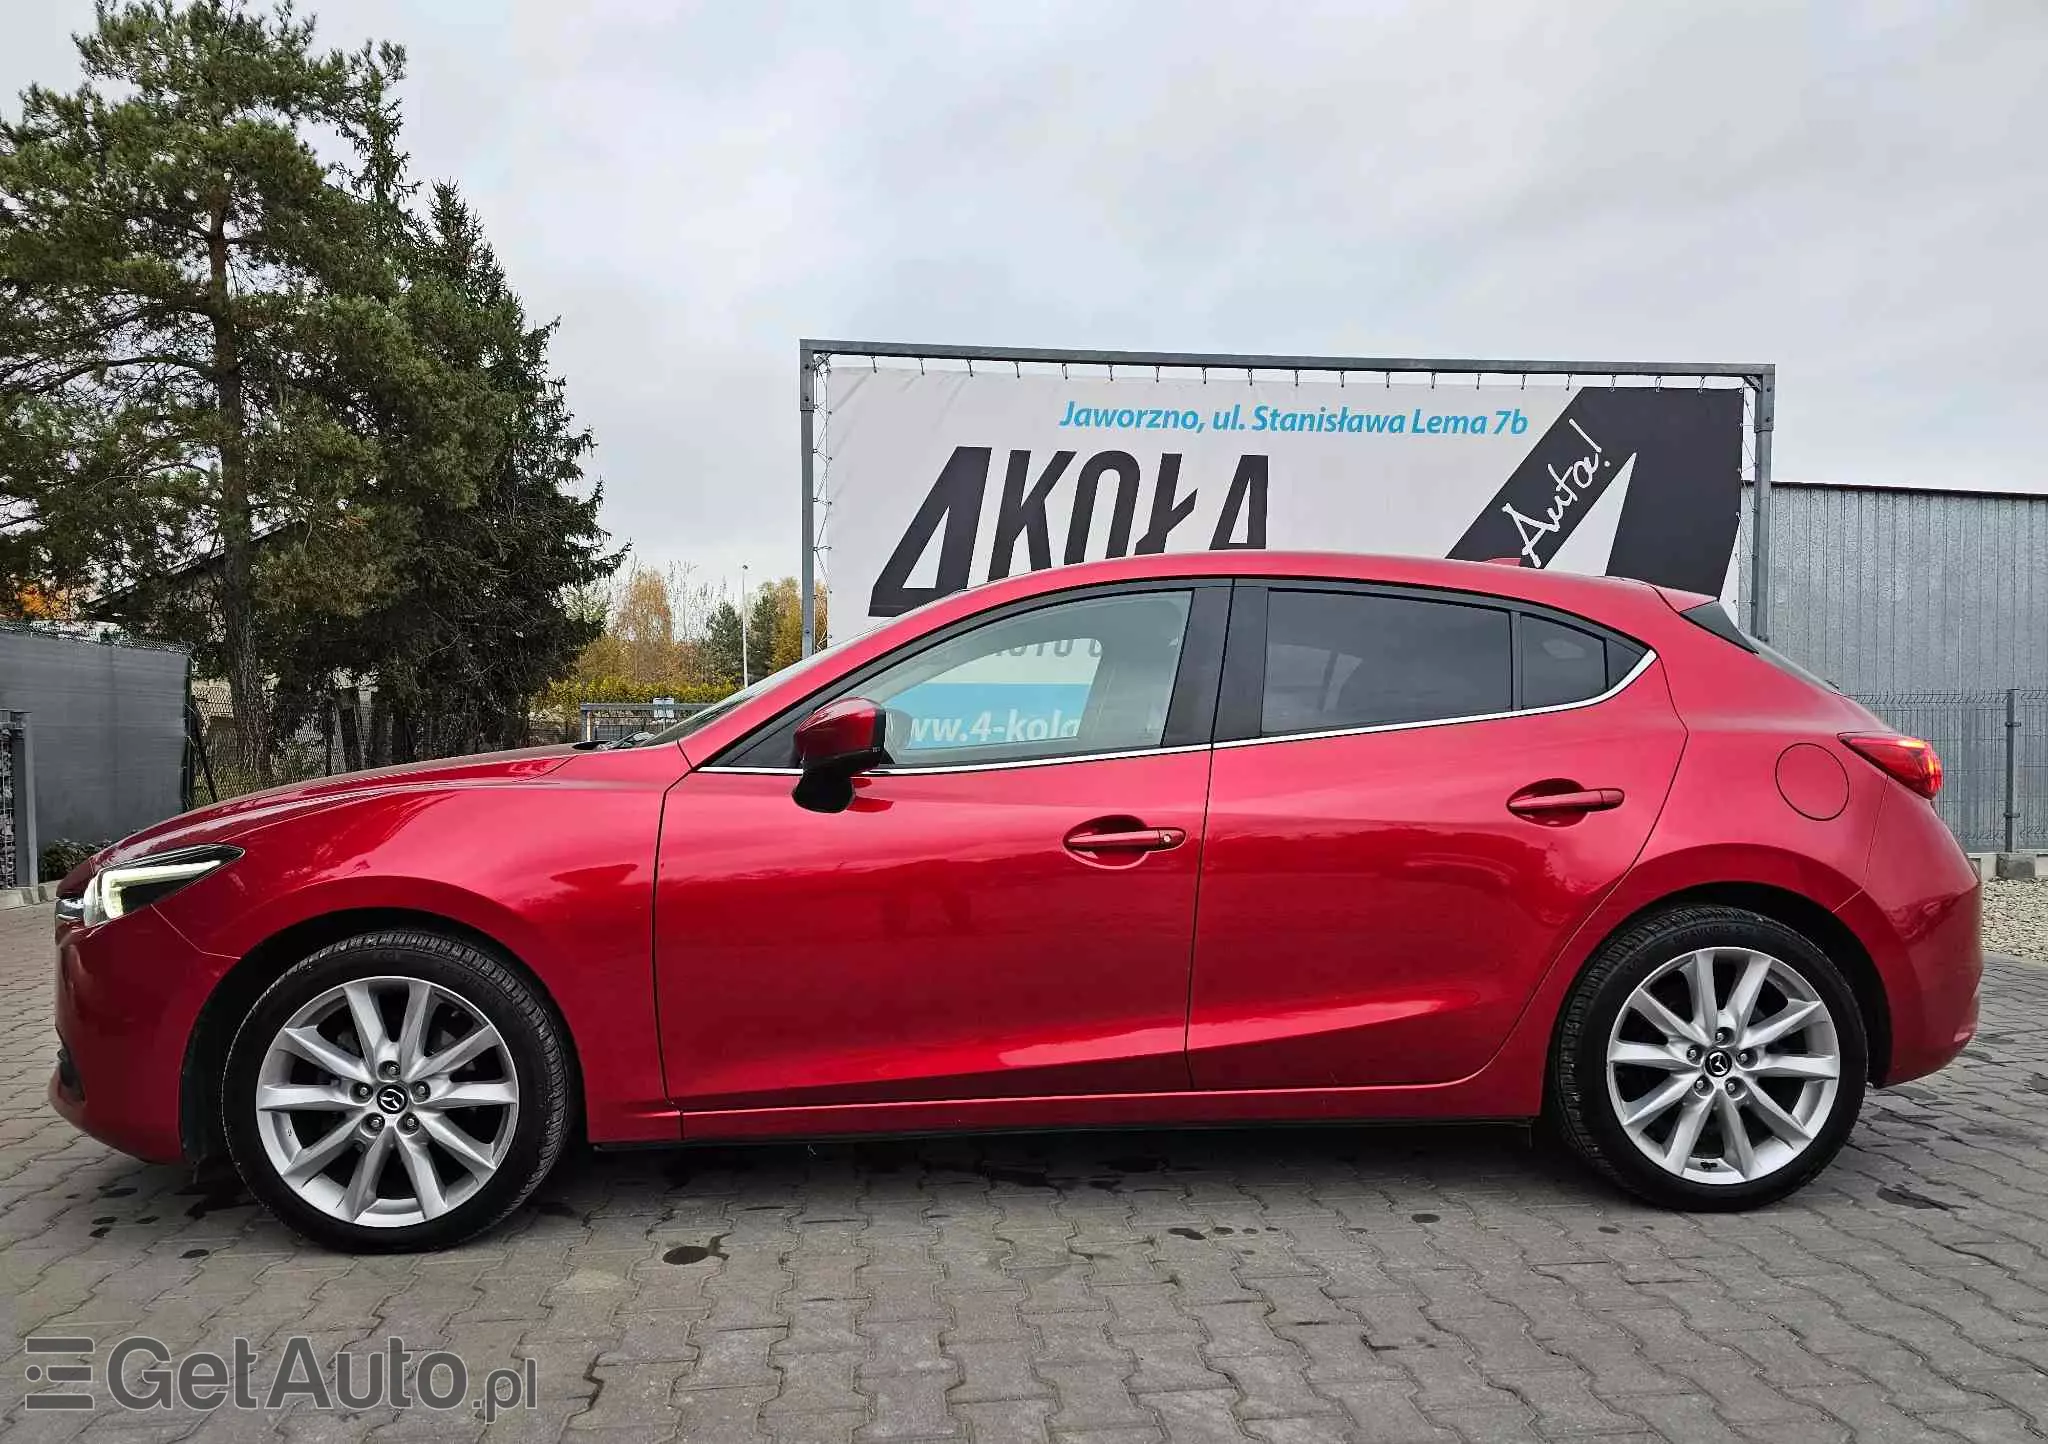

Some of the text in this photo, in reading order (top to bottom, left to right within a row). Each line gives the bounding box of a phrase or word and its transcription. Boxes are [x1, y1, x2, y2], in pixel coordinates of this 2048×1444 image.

[1059, 401, 1529, 434] Jaworzno, ul. Stanisława Lema 7b
